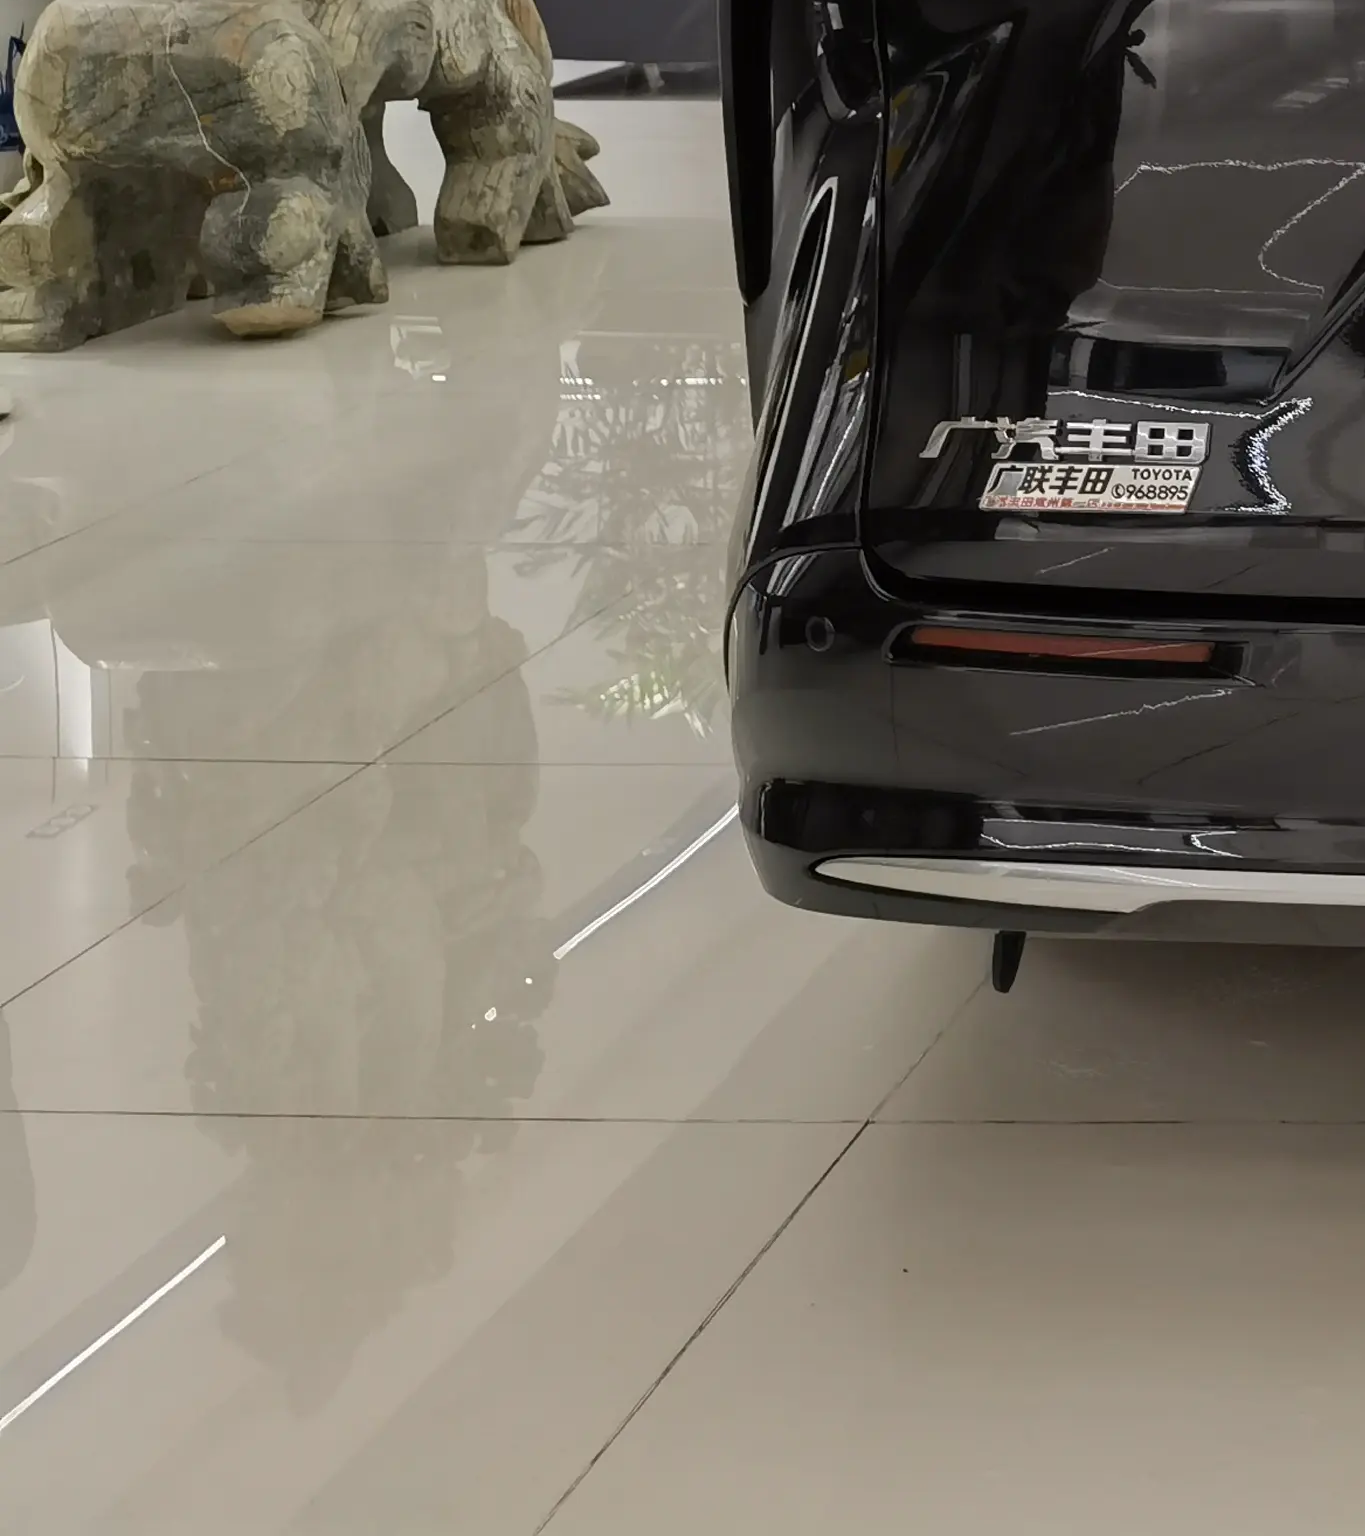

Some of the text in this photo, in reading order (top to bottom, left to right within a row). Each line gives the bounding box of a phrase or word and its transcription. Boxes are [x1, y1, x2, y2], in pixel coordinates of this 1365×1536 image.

[919, 416, 1211, 464] 广汽丰田
[987, 465, 1115, 495] 广联丰田
[1131, 468, 1193, 482] TOYOTA
[1126, 483, 1189, 501] 968895
